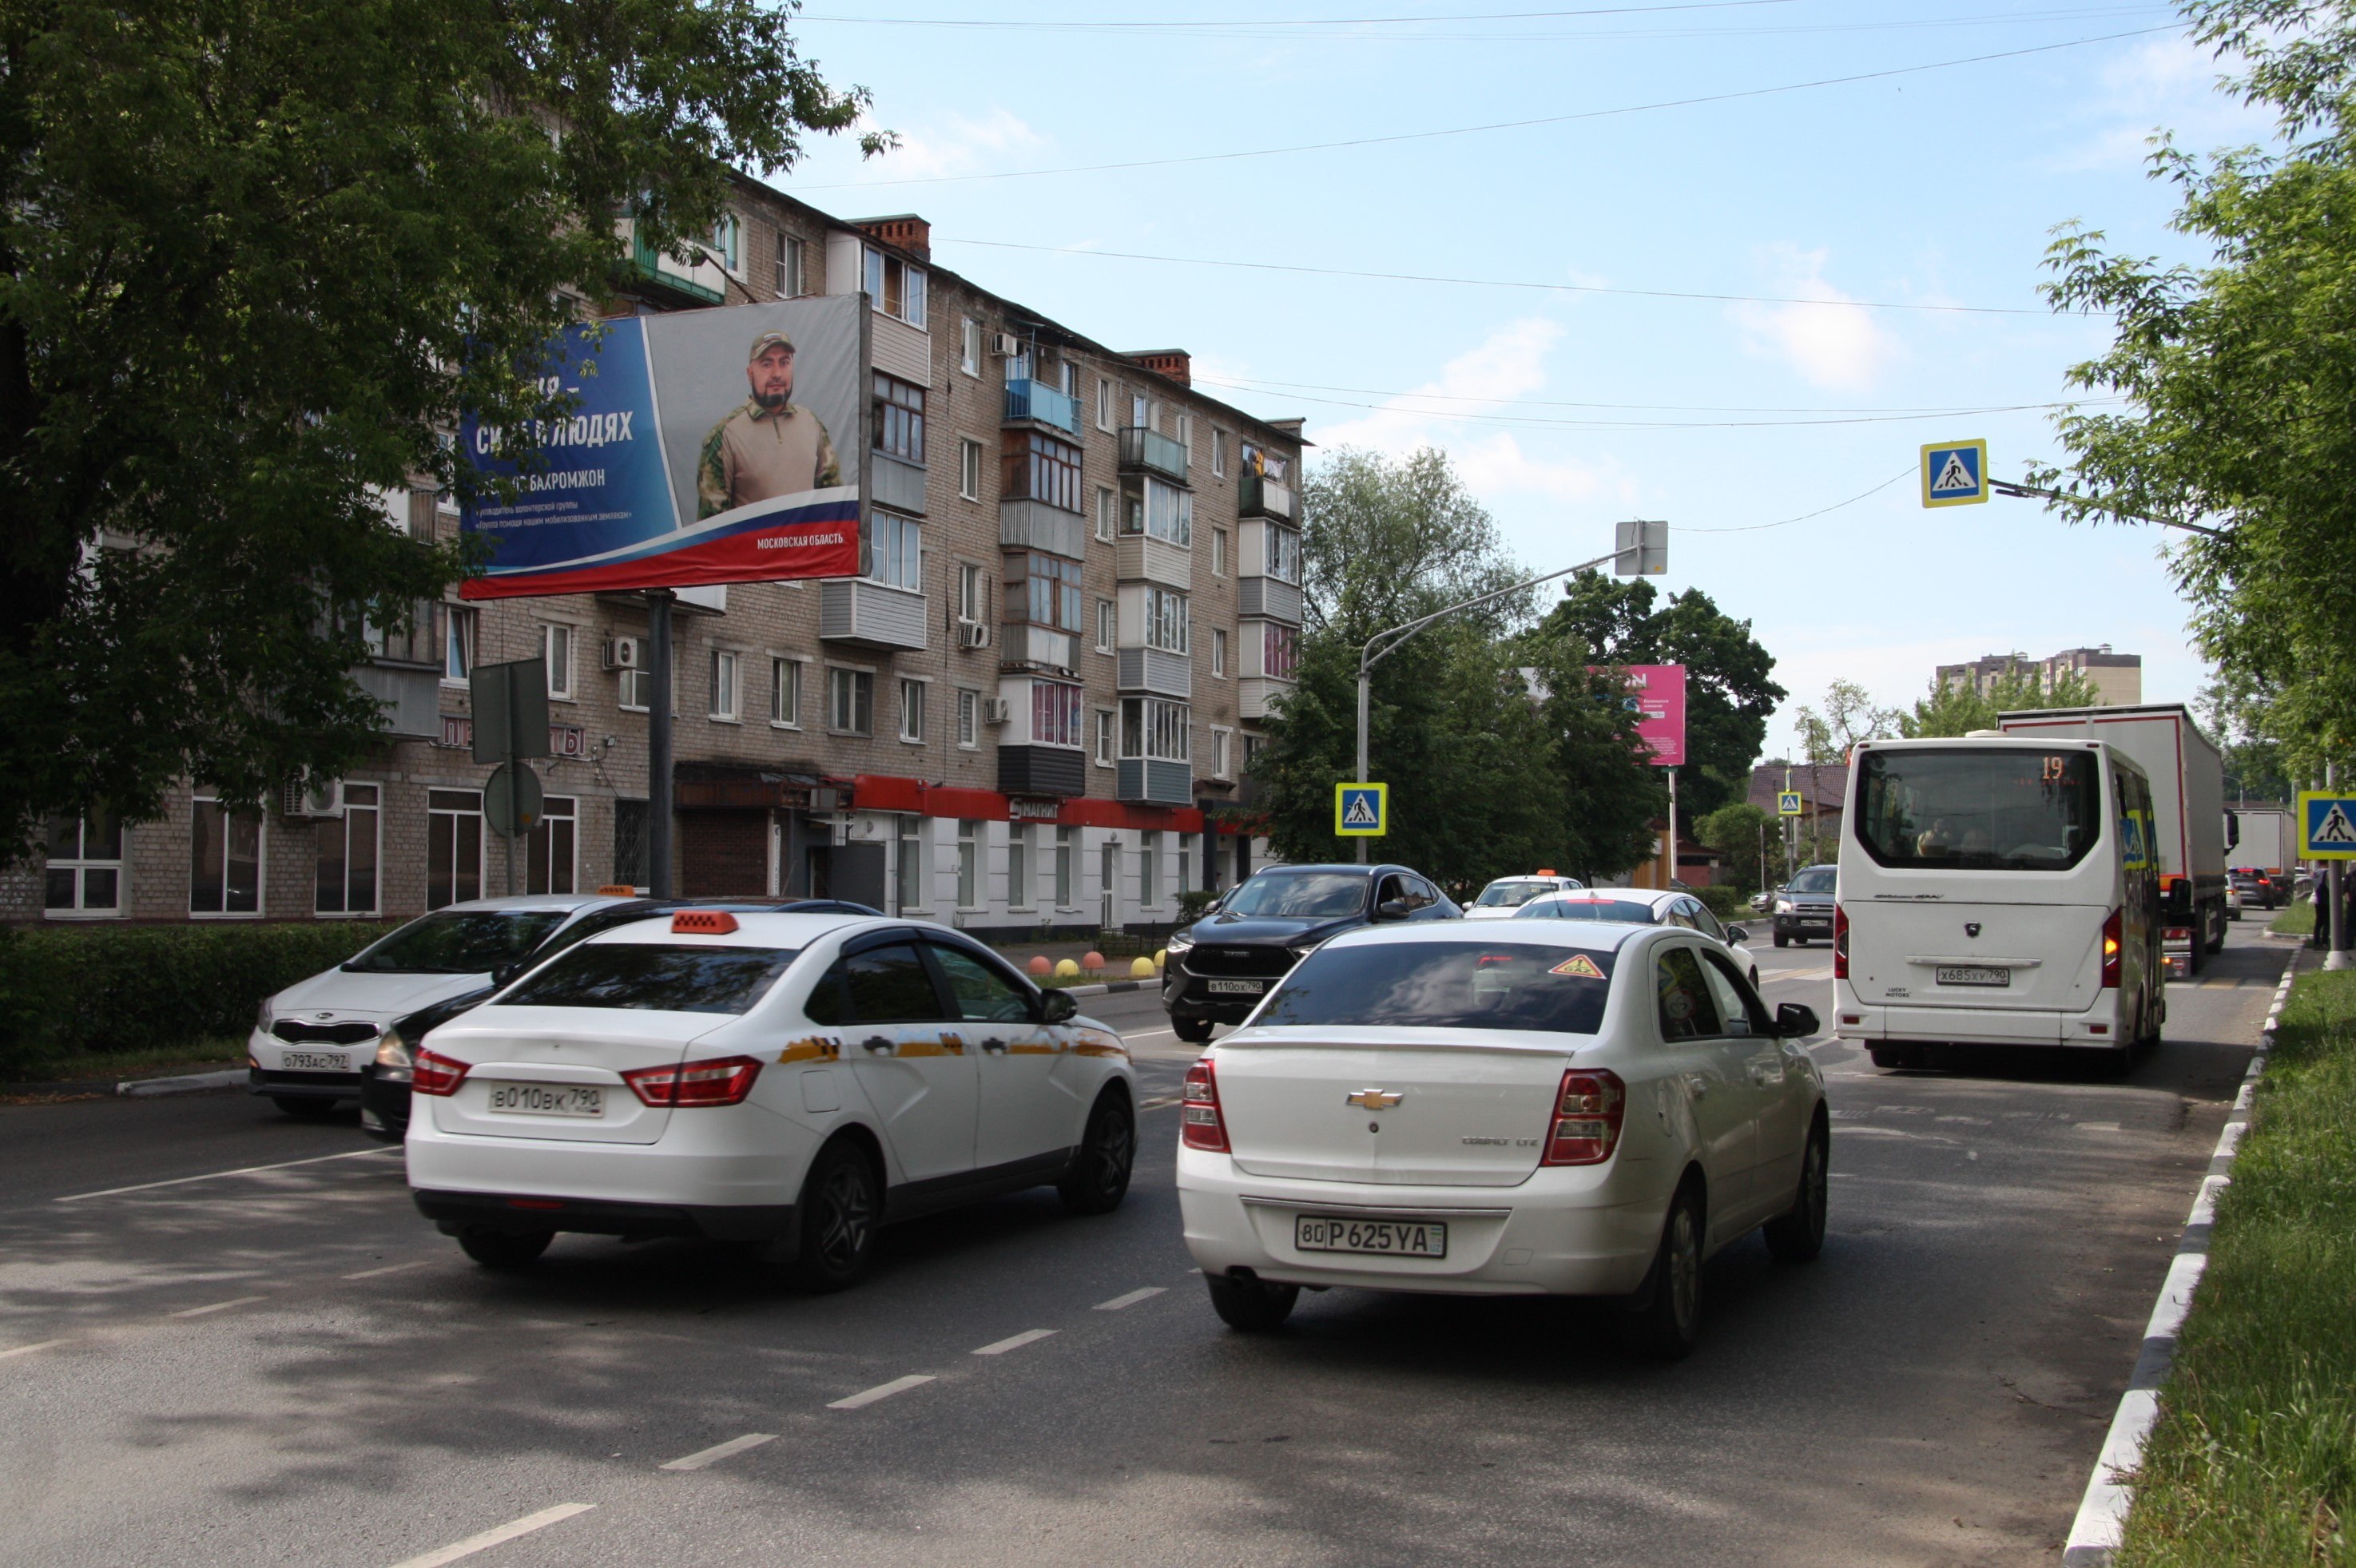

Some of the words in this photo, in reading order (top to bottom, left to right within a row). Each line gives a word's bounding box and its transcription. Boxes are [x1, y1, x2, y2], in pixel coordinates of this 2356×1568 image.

[551, 411, 634, 448] ЛЮДЯХ
[530, 468, 606, 491] БАХРОМЖОН
[556, 500, 578, 511] группы
[499, 518, 522, 528] помощи
[523, 517, 543, 526] нашим
[545, 514, 598, 525] мобилизованным
[757, 536, 808, 550] МОСКОВСКАЯ
[809, 533, 843, 546] ОБЛАСТЬ
[2043, 756, 2063, 780] 19
[1023, 802, 1058, 819] МАГНИТ
[1461, 1136, 1509, 1146] COBALT
[1516, 1137, 1539, 1147] LTZ
